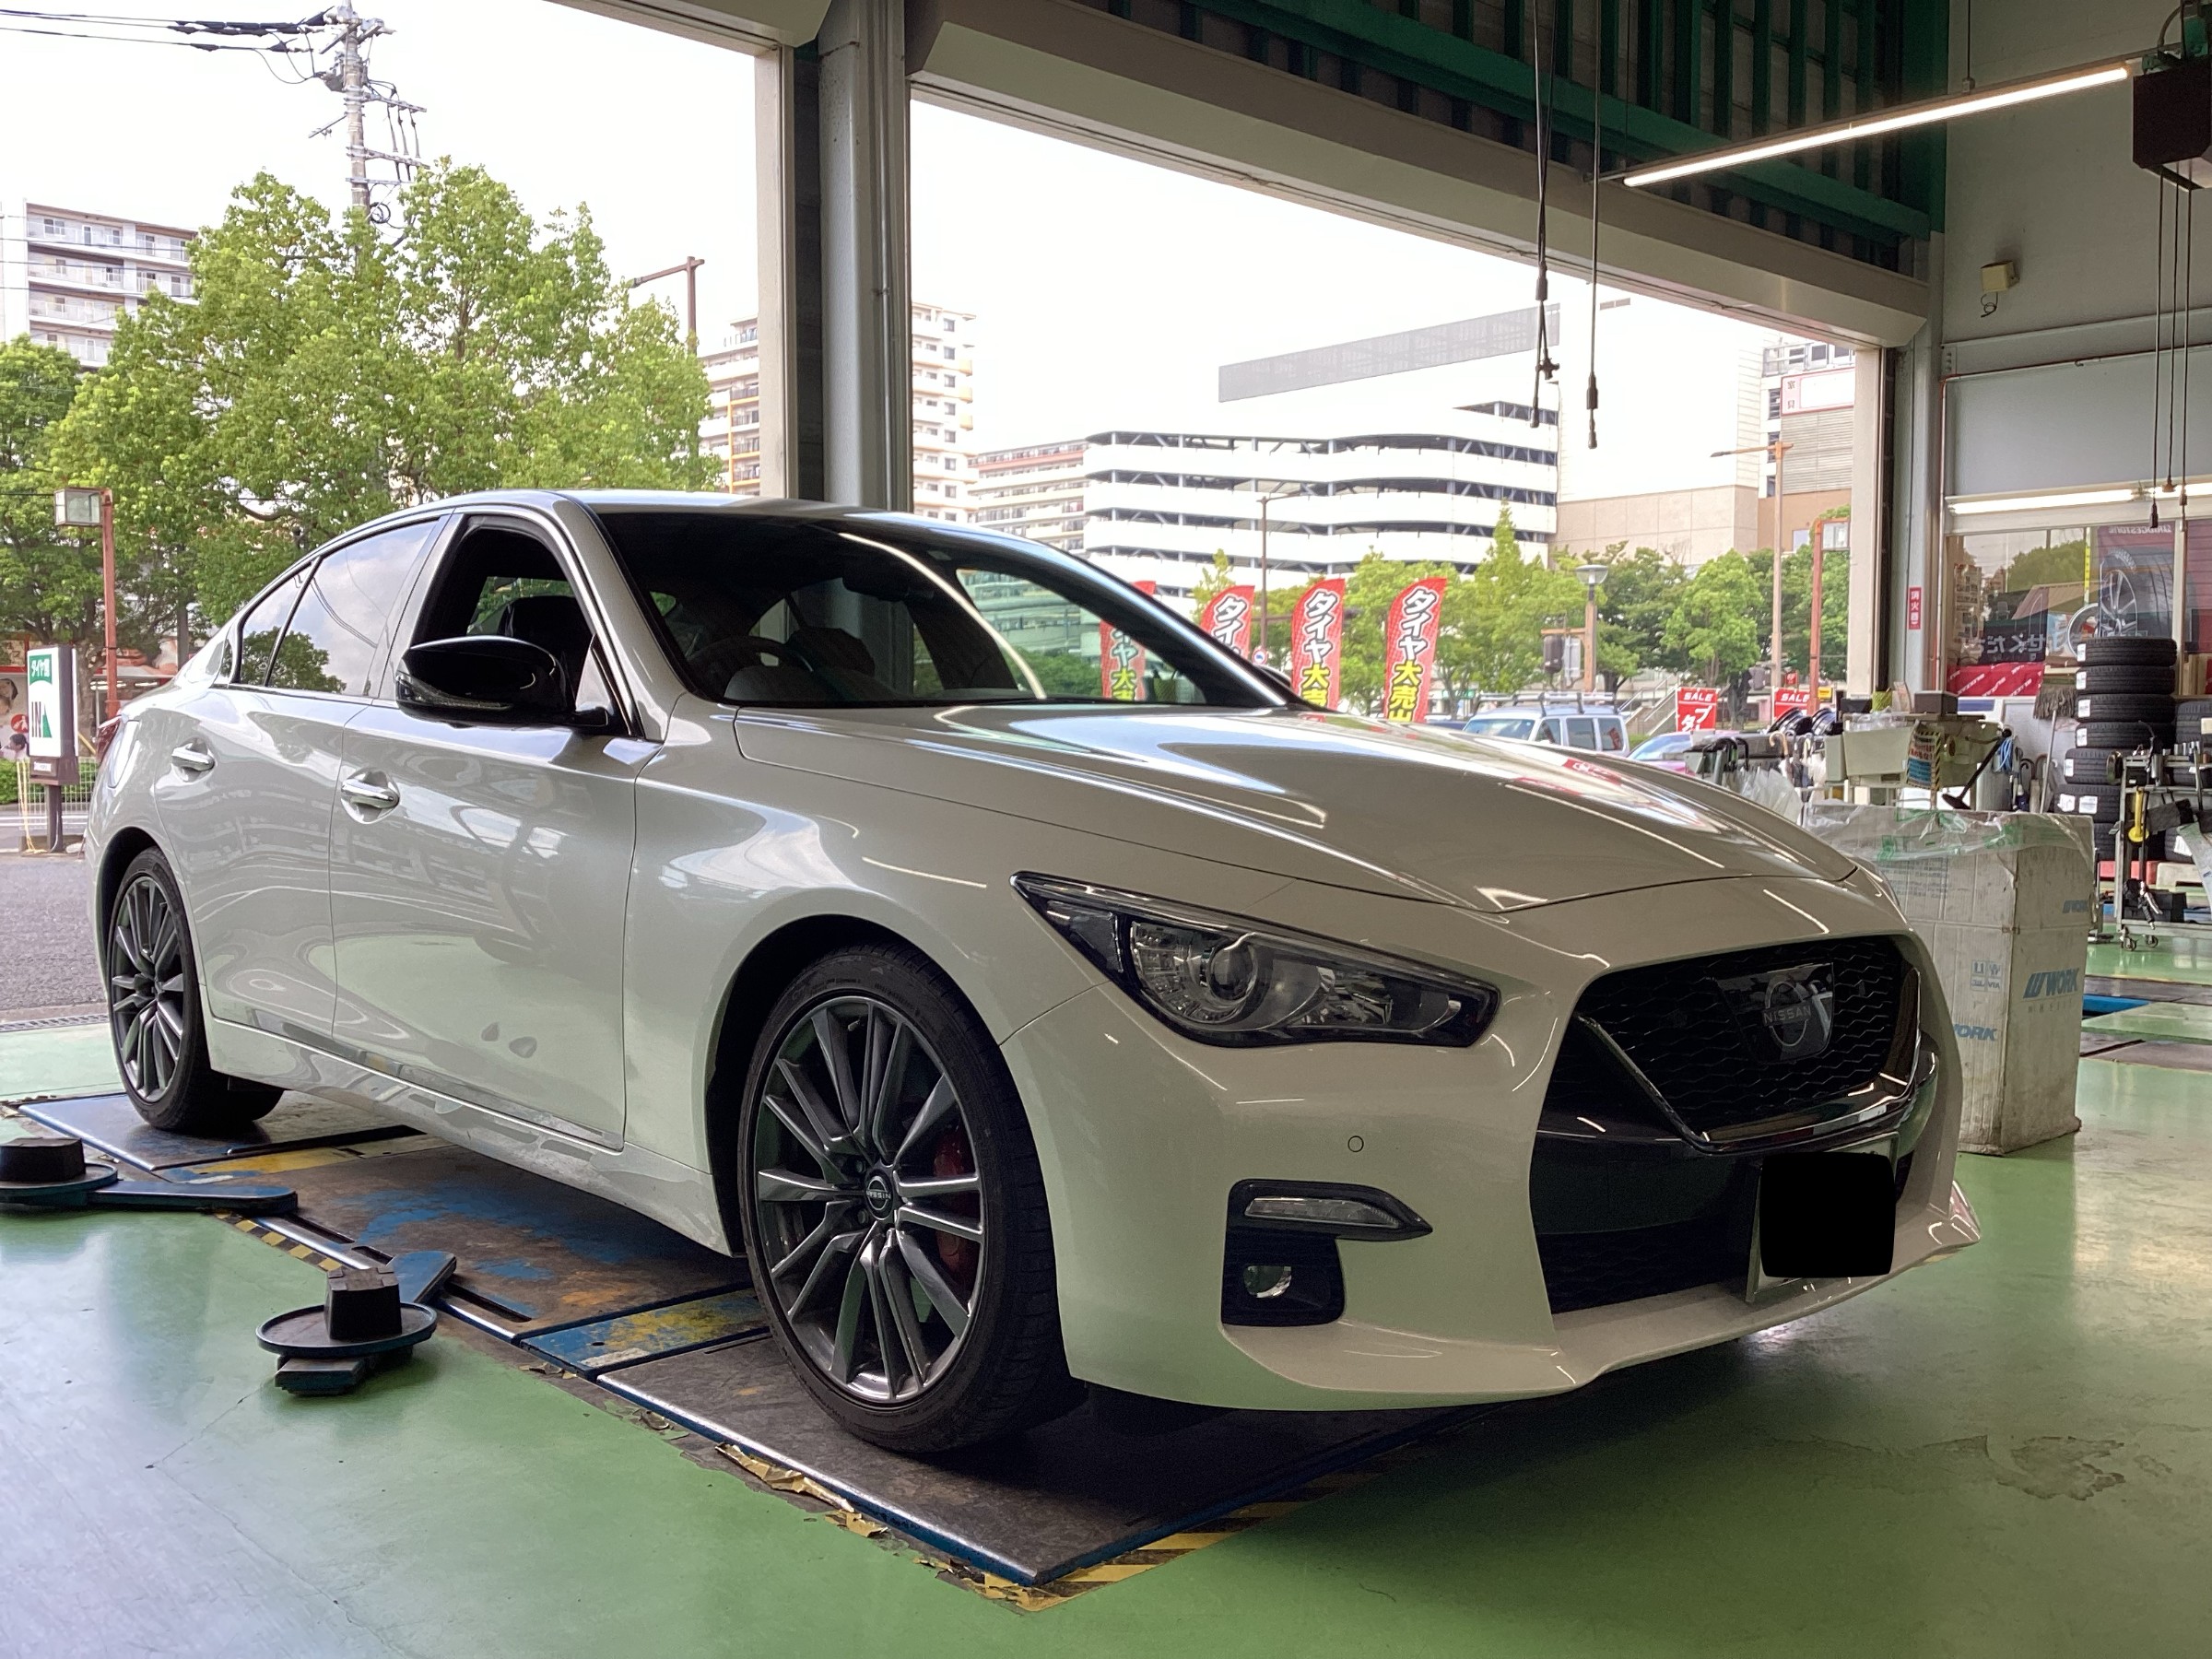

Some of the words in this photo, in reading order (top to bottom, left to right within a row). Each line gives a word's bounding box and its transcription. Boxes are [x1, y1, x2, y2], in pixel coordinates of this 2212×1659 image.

[1214, 595, 1248, 656] タイ
[1683, 692, 1714, 701] SALE
[2044, 968, 2079, 996] WORK
[1763, 1005, 1811, 1025] NISSAN
